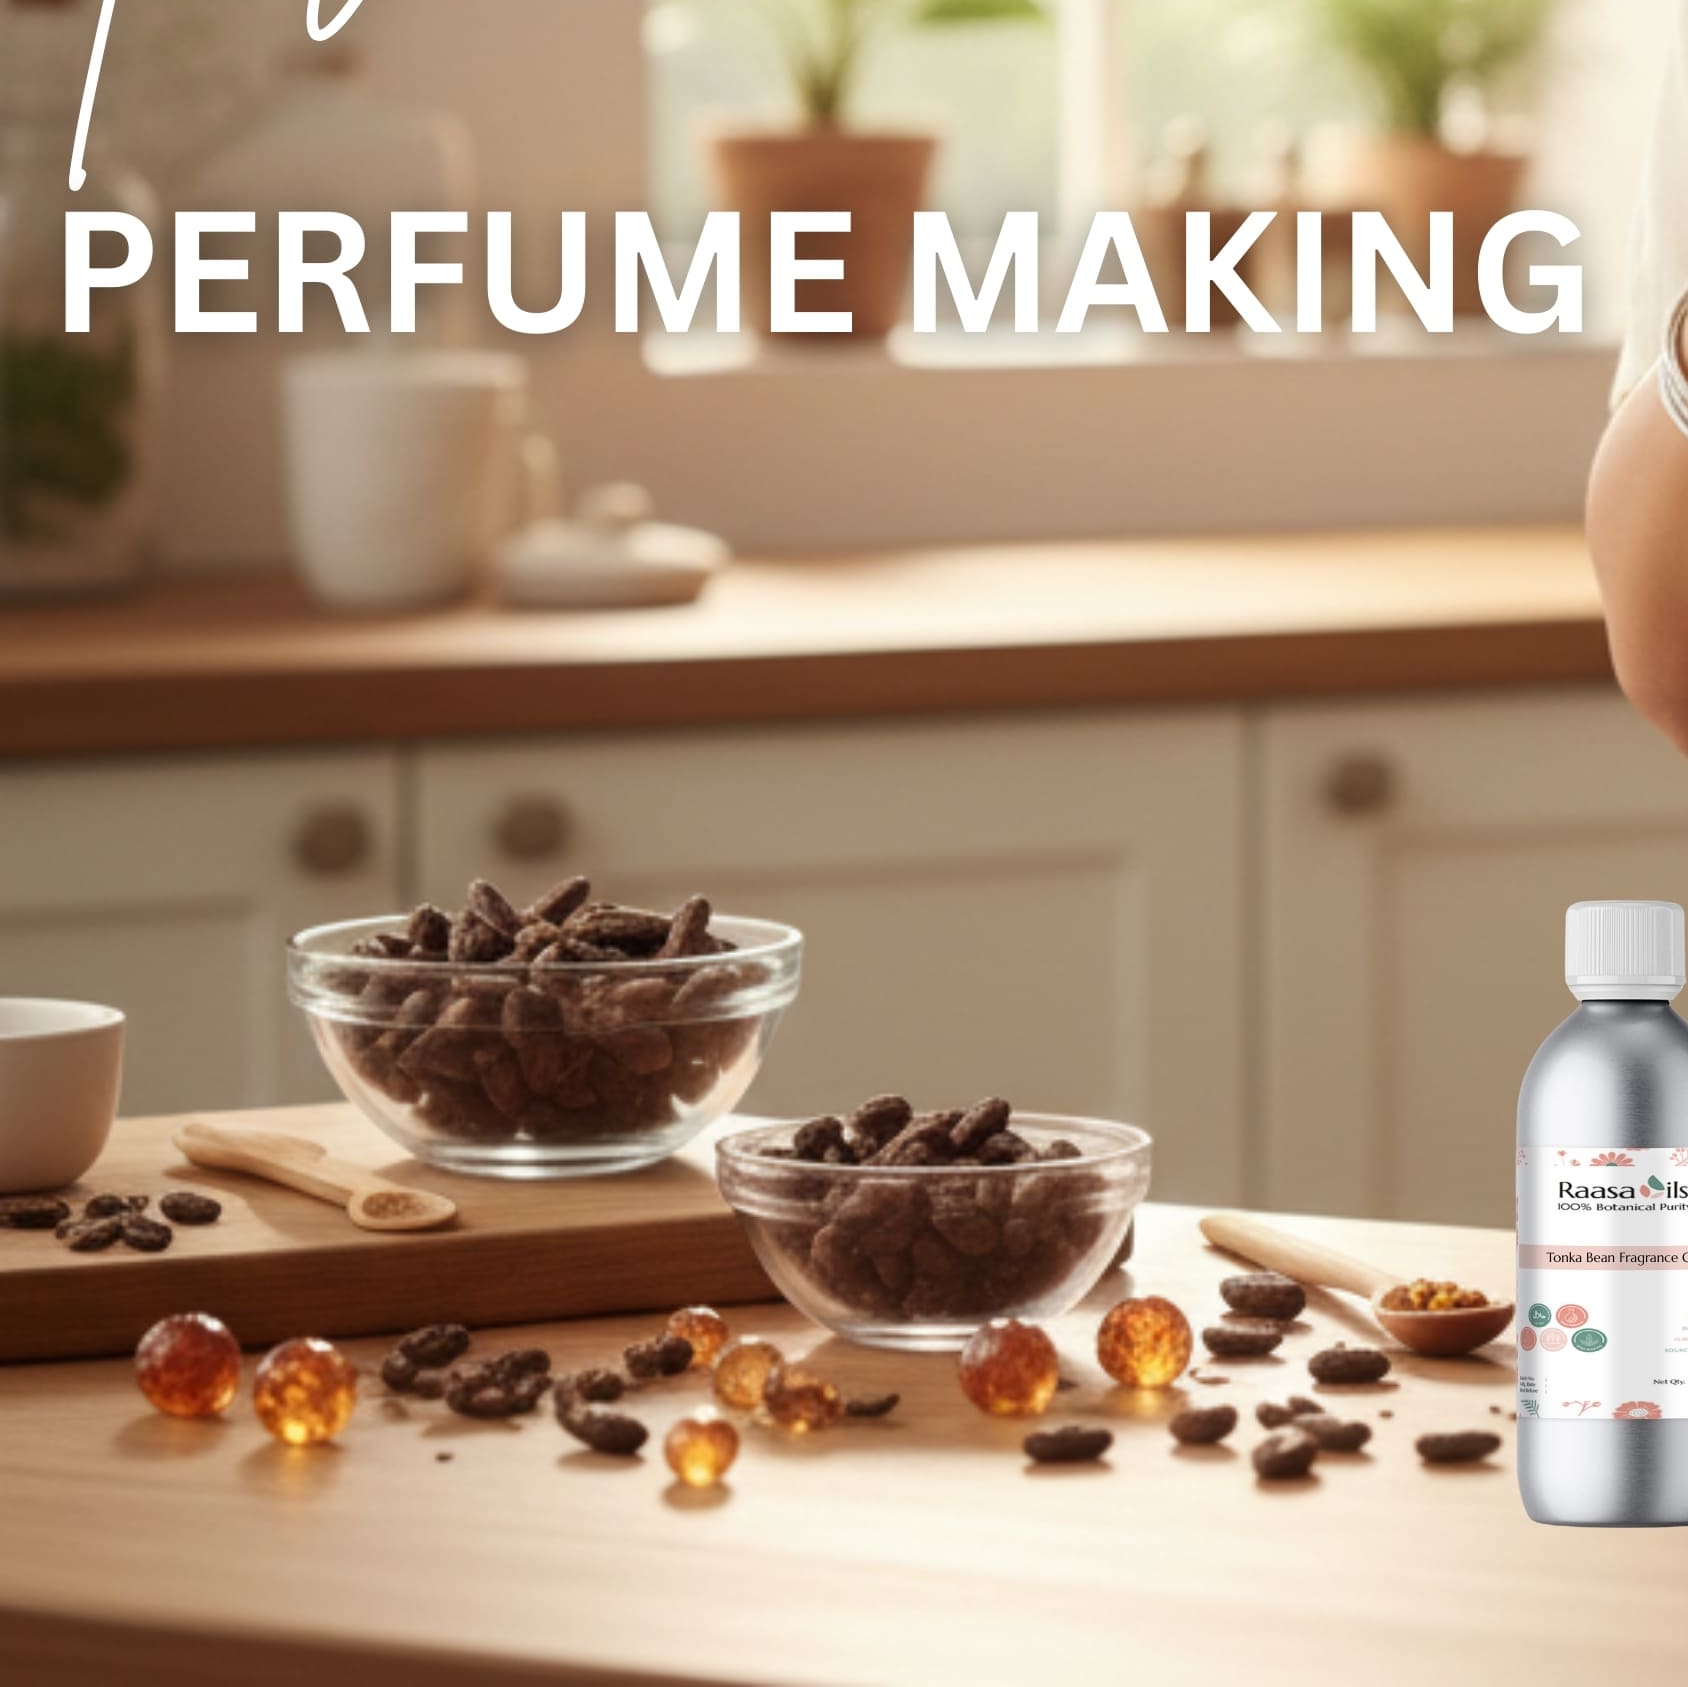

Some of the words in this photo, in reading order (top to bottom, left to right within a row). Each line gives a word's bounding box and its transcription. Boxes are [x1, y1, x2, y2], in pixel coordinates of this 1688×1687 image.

[1558, 1181, 1635, 1199] Raasa
[1557, 1202, 1592, 1212] 100%
[1596, 1202, 1656, 1212] Botanical
[1546, 1251, 1582, 1263] Tonka
[1586, 1251, 1615, 1263] Bean
[1619, 1251, 1678, 1267] Fragrance
